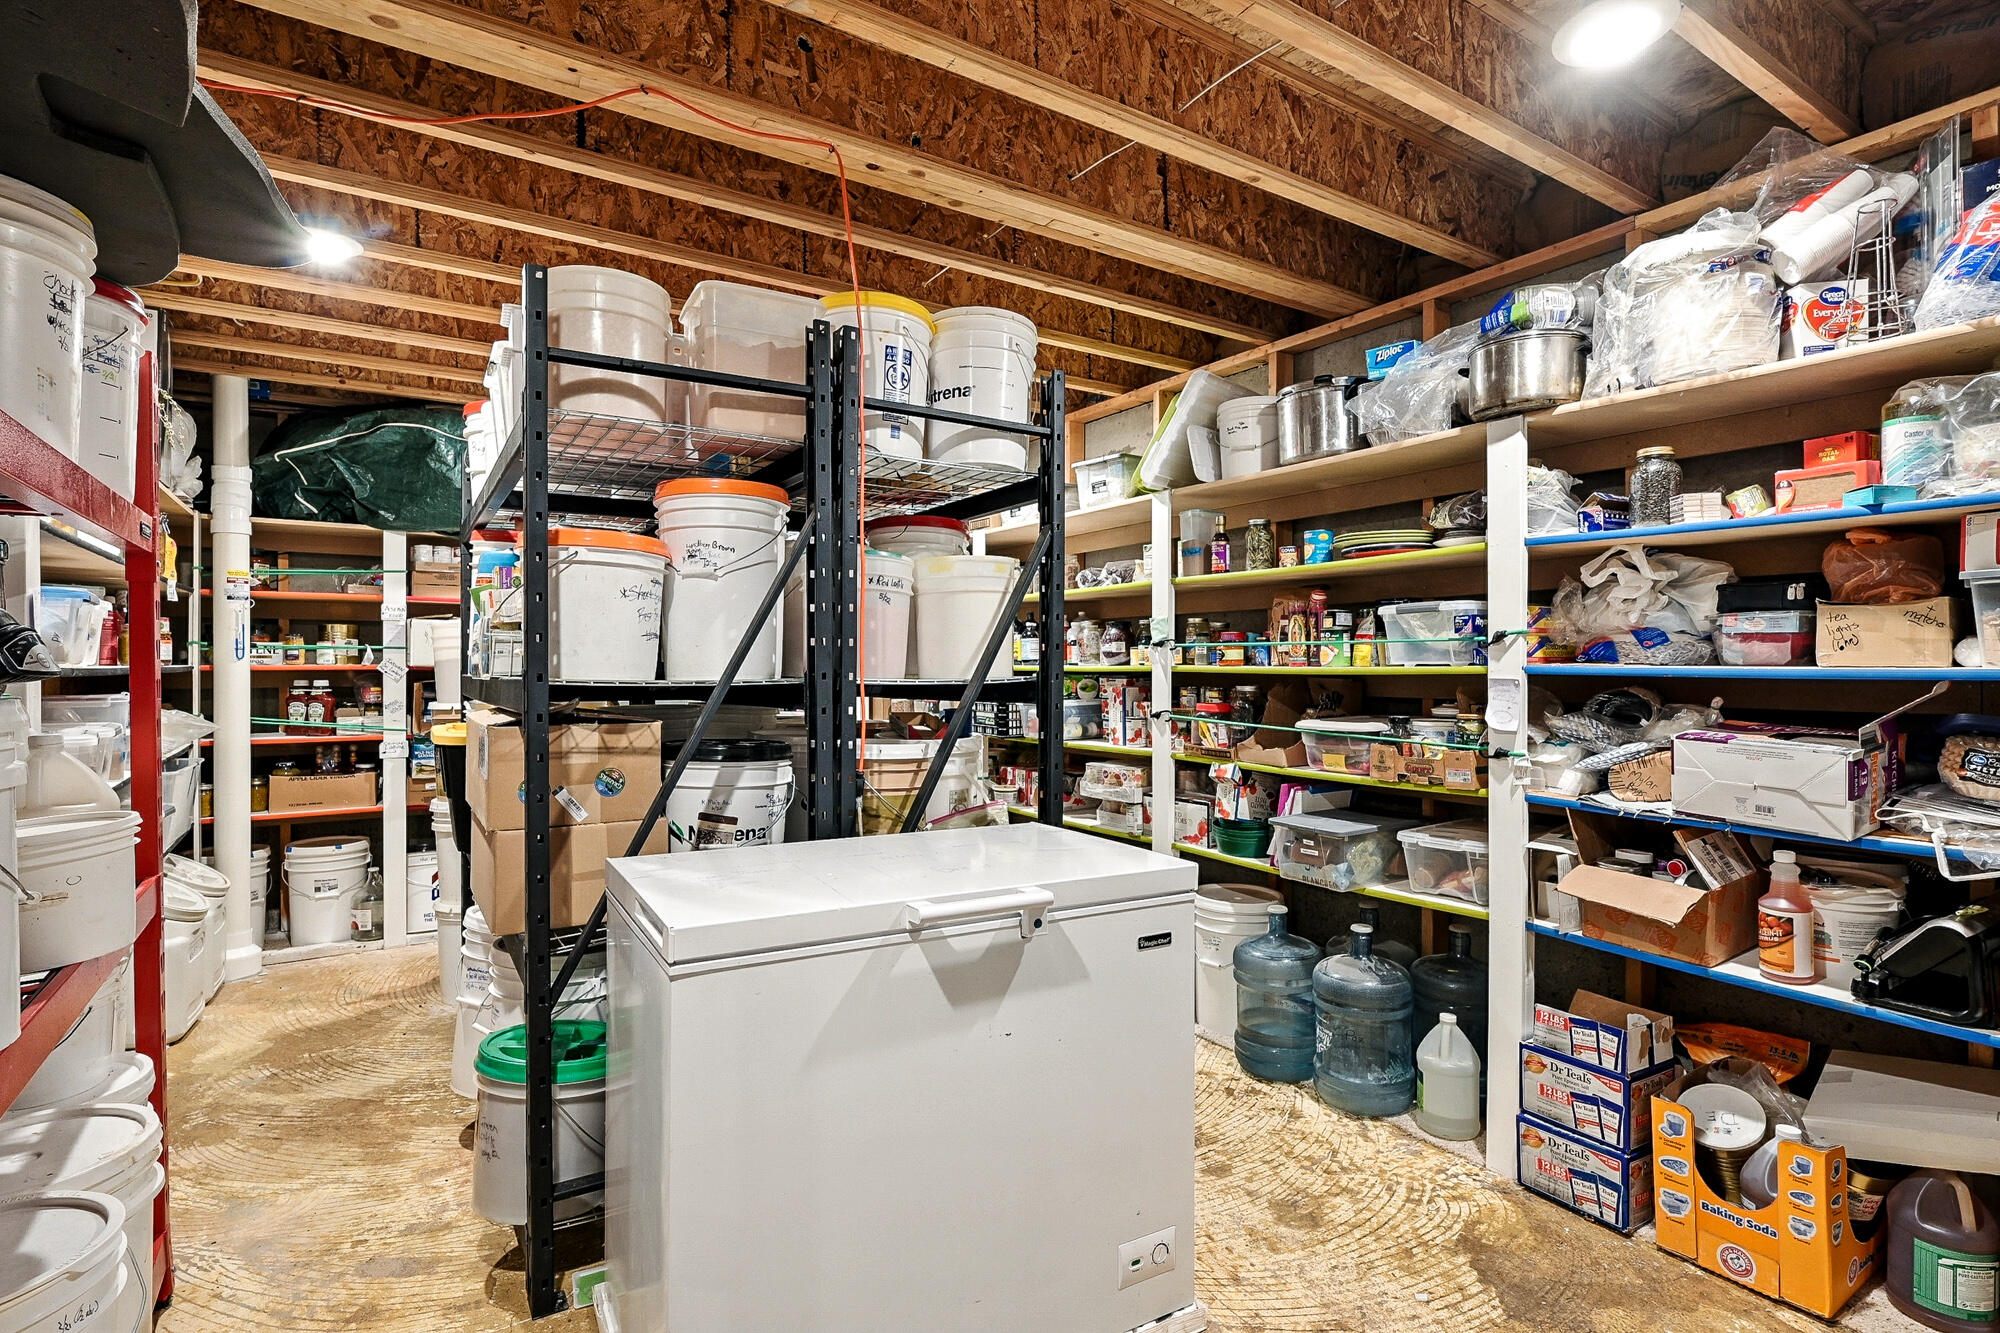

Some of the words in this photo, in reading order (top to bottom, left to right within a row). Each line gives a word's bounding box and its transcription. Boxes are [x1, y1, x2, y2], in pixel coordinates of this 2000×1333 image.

[1822, 290, 1845, 299] Great
[1376, 345, 1404, 363] Ziploc
[1818, 449, 1840, 458] ROYAL
[1826, 612, 1849, 623] tea
[1826, 622, 1860, 641] lights
[1627, 770, 1658, 790] Mylar
[1861, 768, 1868, 786] 13
[688, 825, 766, 841] Nena
[1540, 1010, 1548, 1020] 12
[1549, 1014, 1565, 1025] LBS
[1580, 1030, 1595, 1038] Teal's
[1550, 1061, 1564, 1076] Dr
[1564, 1065, 1592, 1085] Teal's
[1543, 1084, 1552, 1095] 12
[1553, 1088, 1568, 1100] LBS
[1548, 1136, 1562, 1150] Dr
[1562, 1140, 1590, 1162] Teal's
[1541, 1160, 1549, 1170] 12
[1550, 1163, 1566, 1176] LBS
[1701, 1201, 1744, 1227] Baking
[1744, 1218, 1778, 1238] Soda
